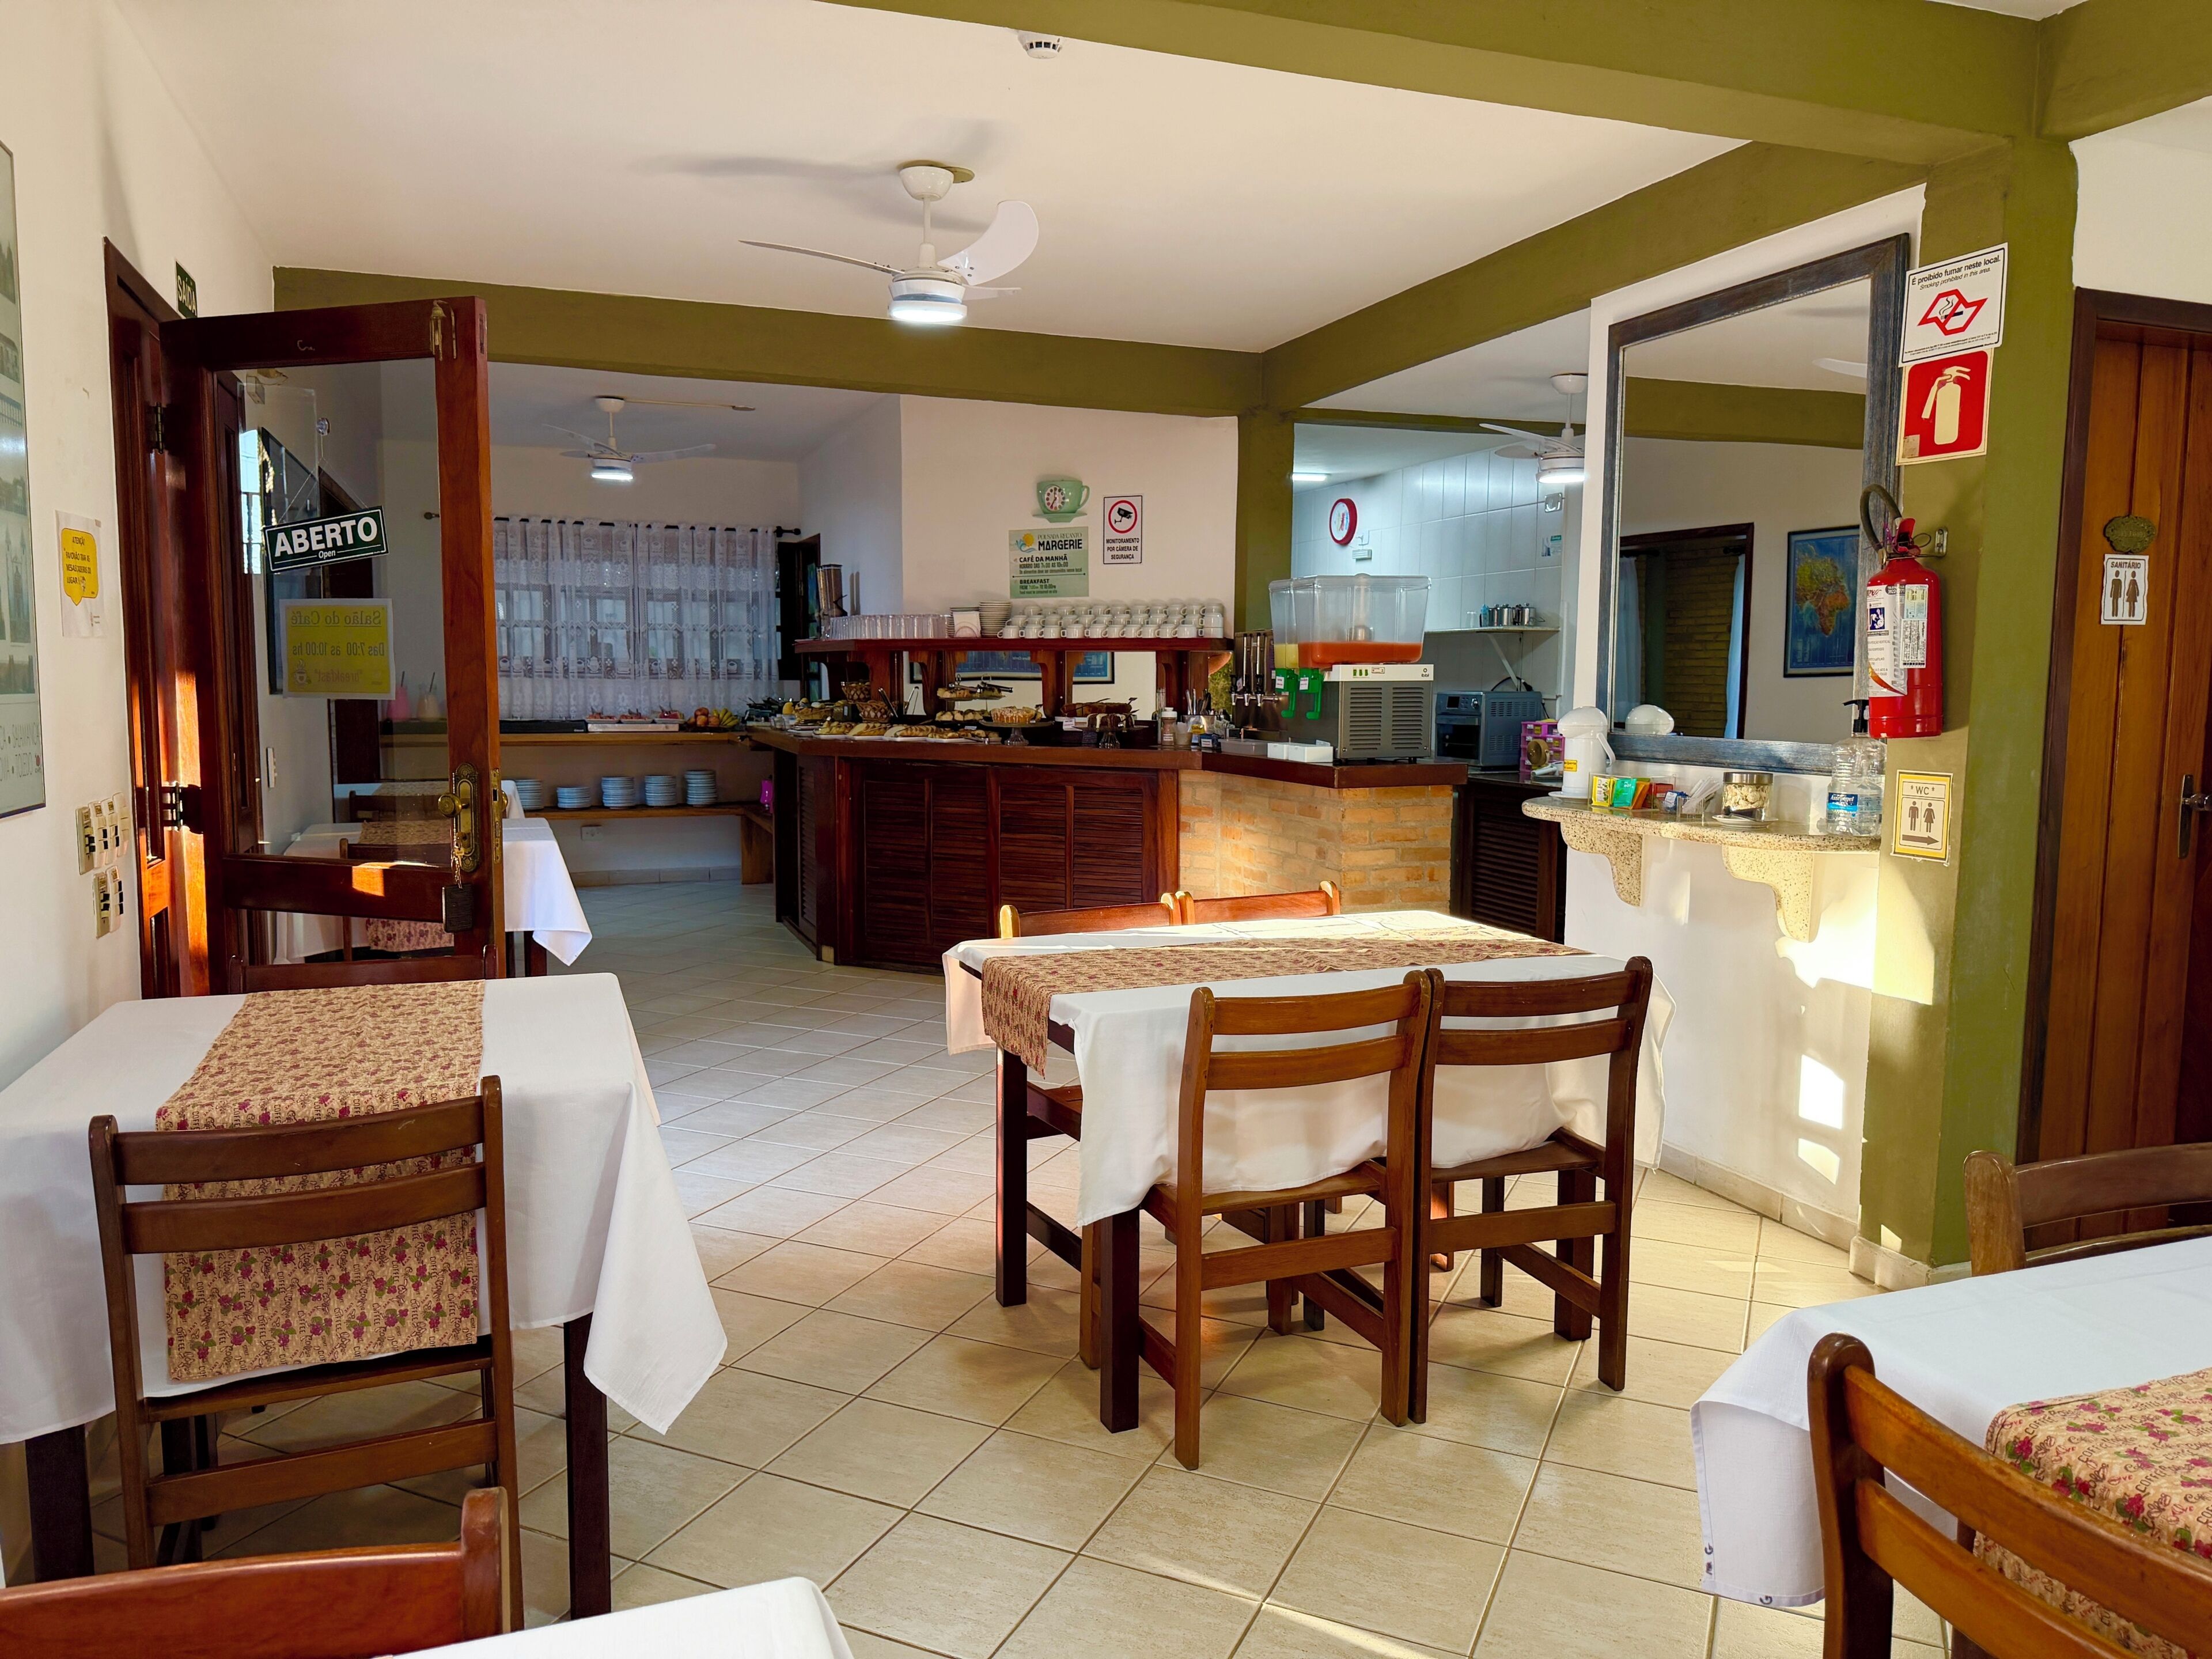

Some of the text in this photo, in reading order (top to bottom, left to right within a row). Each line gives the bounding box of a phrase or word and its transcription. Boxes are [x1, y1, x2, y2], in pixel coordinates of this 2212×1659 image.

[1911, 255, 2001, 286] É proibido fumar neste local.
[1919, 279, 1940, 290] Smoking
[1940, 275, 1963, 287] prohibited
[177, 275, 197, 317] SAÍDA
[274, 516, 378, 557] ABERTO
[1038, 539, 1083, 551] MARGERIE
[318, 550, 336, 560] Open
[1019, 555, 1035, 563] CAFÉ
[1045, 554, 1068, 562] MANHÃ
[2111, 560, 2141, 569] SANITÁRIO
[1915, 786, 1930, 795] WC
[2135, 1465, 2169, 1494] COFFEE
